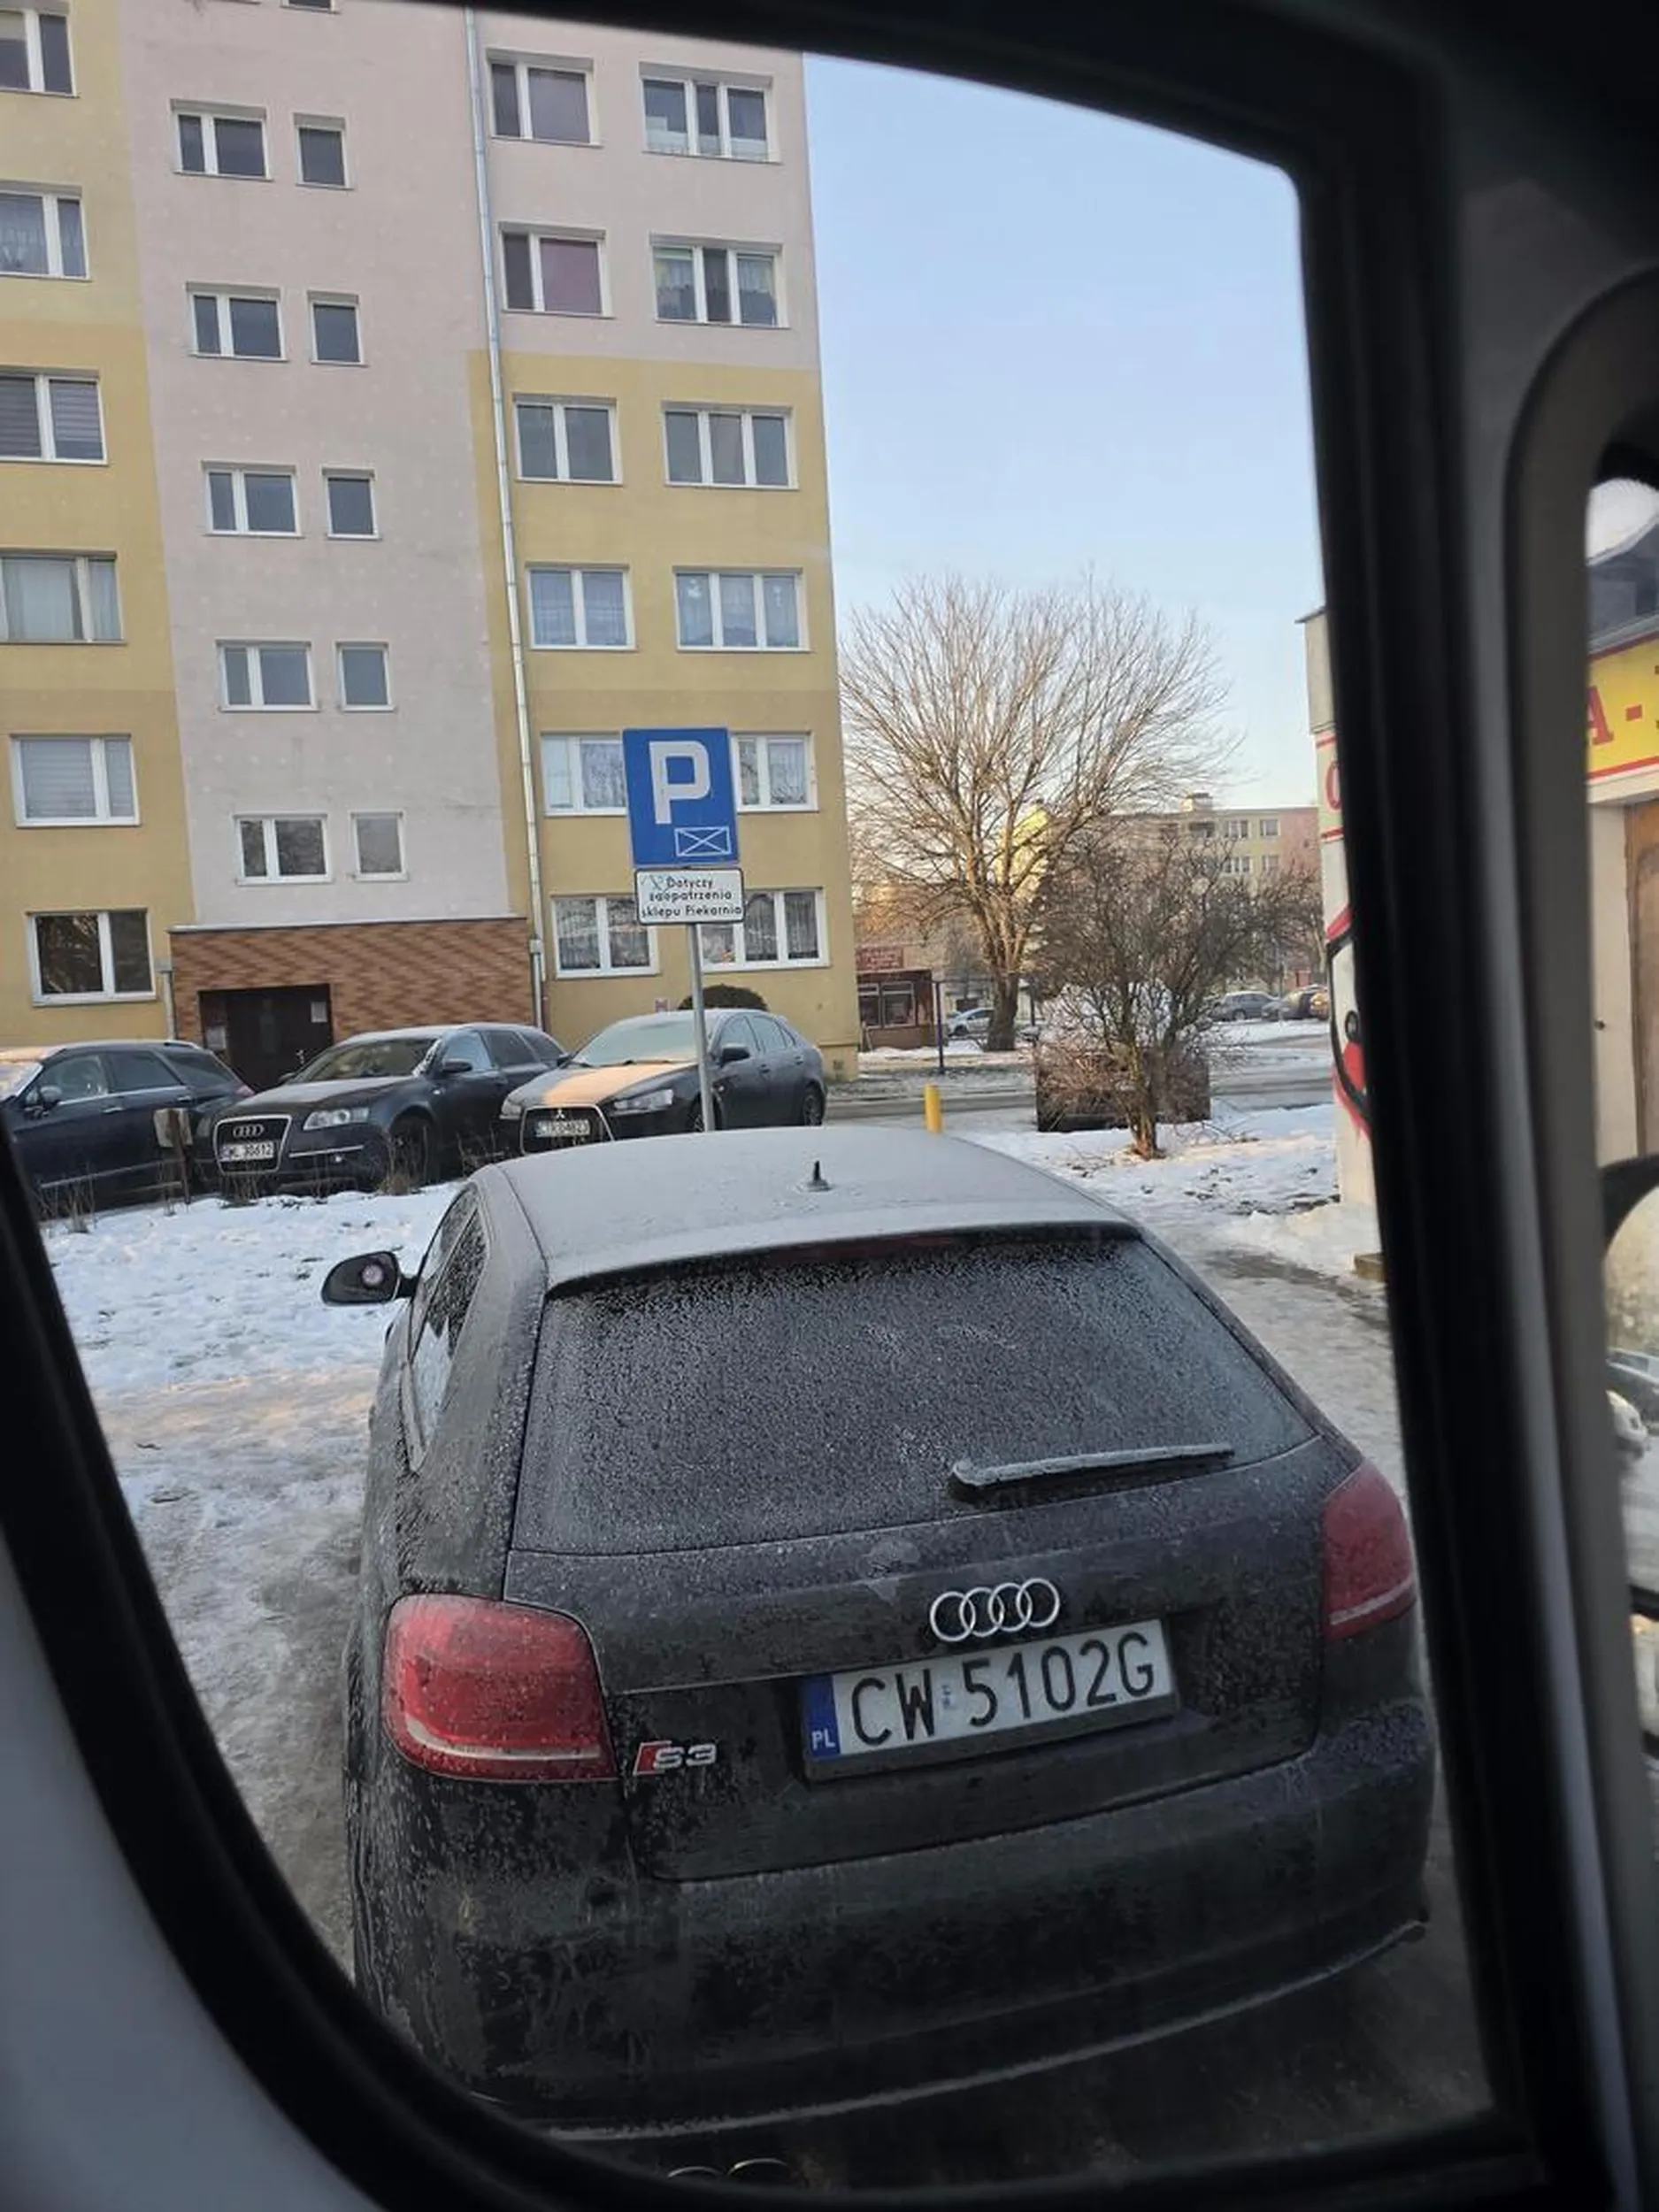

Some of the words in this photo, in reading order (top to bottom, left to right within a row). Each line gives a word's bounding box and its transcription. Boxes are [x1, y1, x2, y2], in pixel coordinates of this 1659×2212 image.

[649, 741, 710, 825] P
[665, 875, 712, 889] Dotyczy
[649, 890, 733, 903] zaopatrzenia
[641, 905, 680, 918] sklepu
[686, 904, 742, 917] Piekarnia
[850, 1668, 935, 1747] CW
[962, 1631, 1154, 1727] 5102G
[811, 1728, 837, 1751] PL
[653, 1744, 717, 1770] S3
